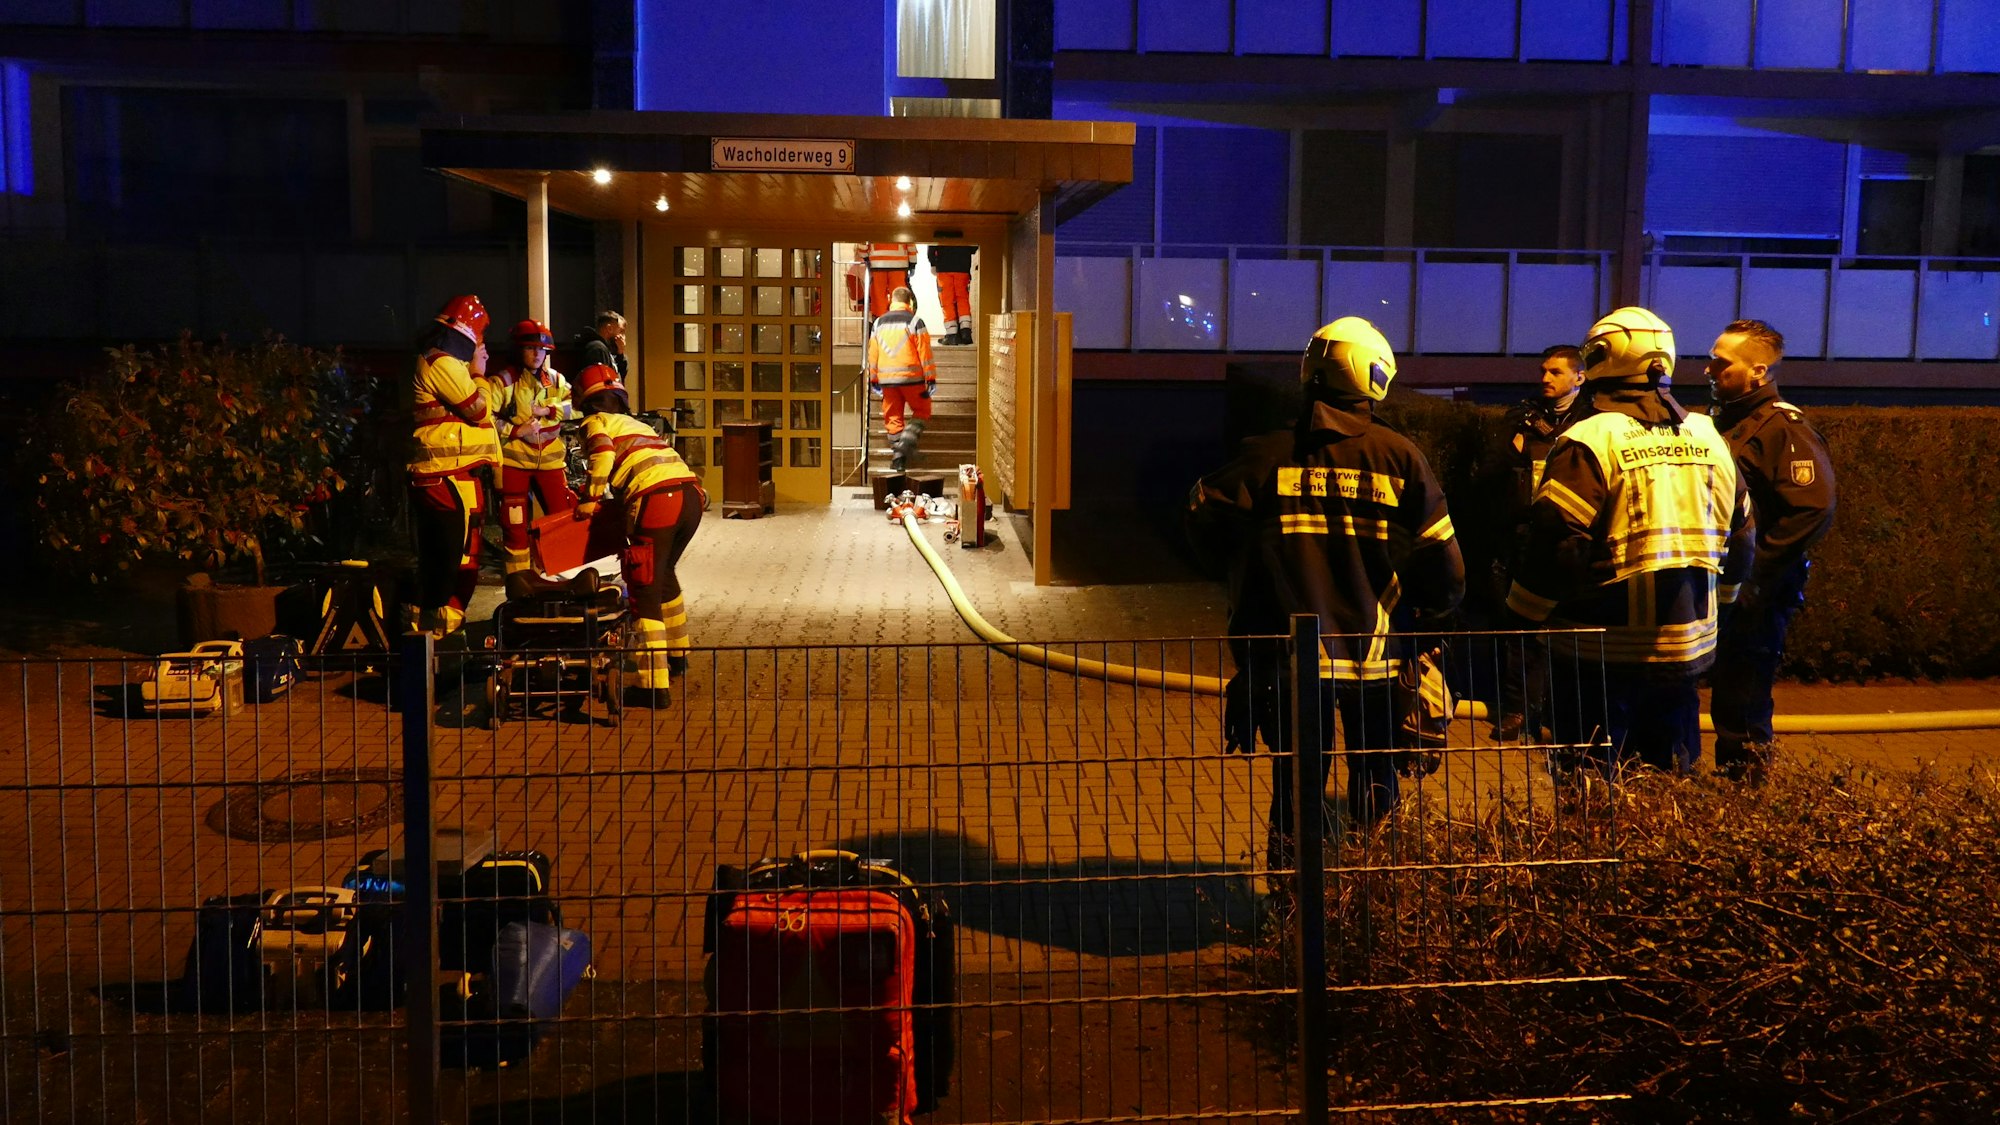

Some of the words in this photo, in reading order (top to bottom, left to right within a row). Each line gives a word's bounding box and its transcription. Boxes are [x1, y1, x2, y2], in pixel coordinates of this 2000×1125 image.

[722, 146, 833, 166] Wacholderweg
[839, 149, 847, 163] 9
[1308, 469, 1374, 484] Feurwer
[1293, 482, 1328, 492] Snk
[1334, 483, 1386, 499] Augutin
